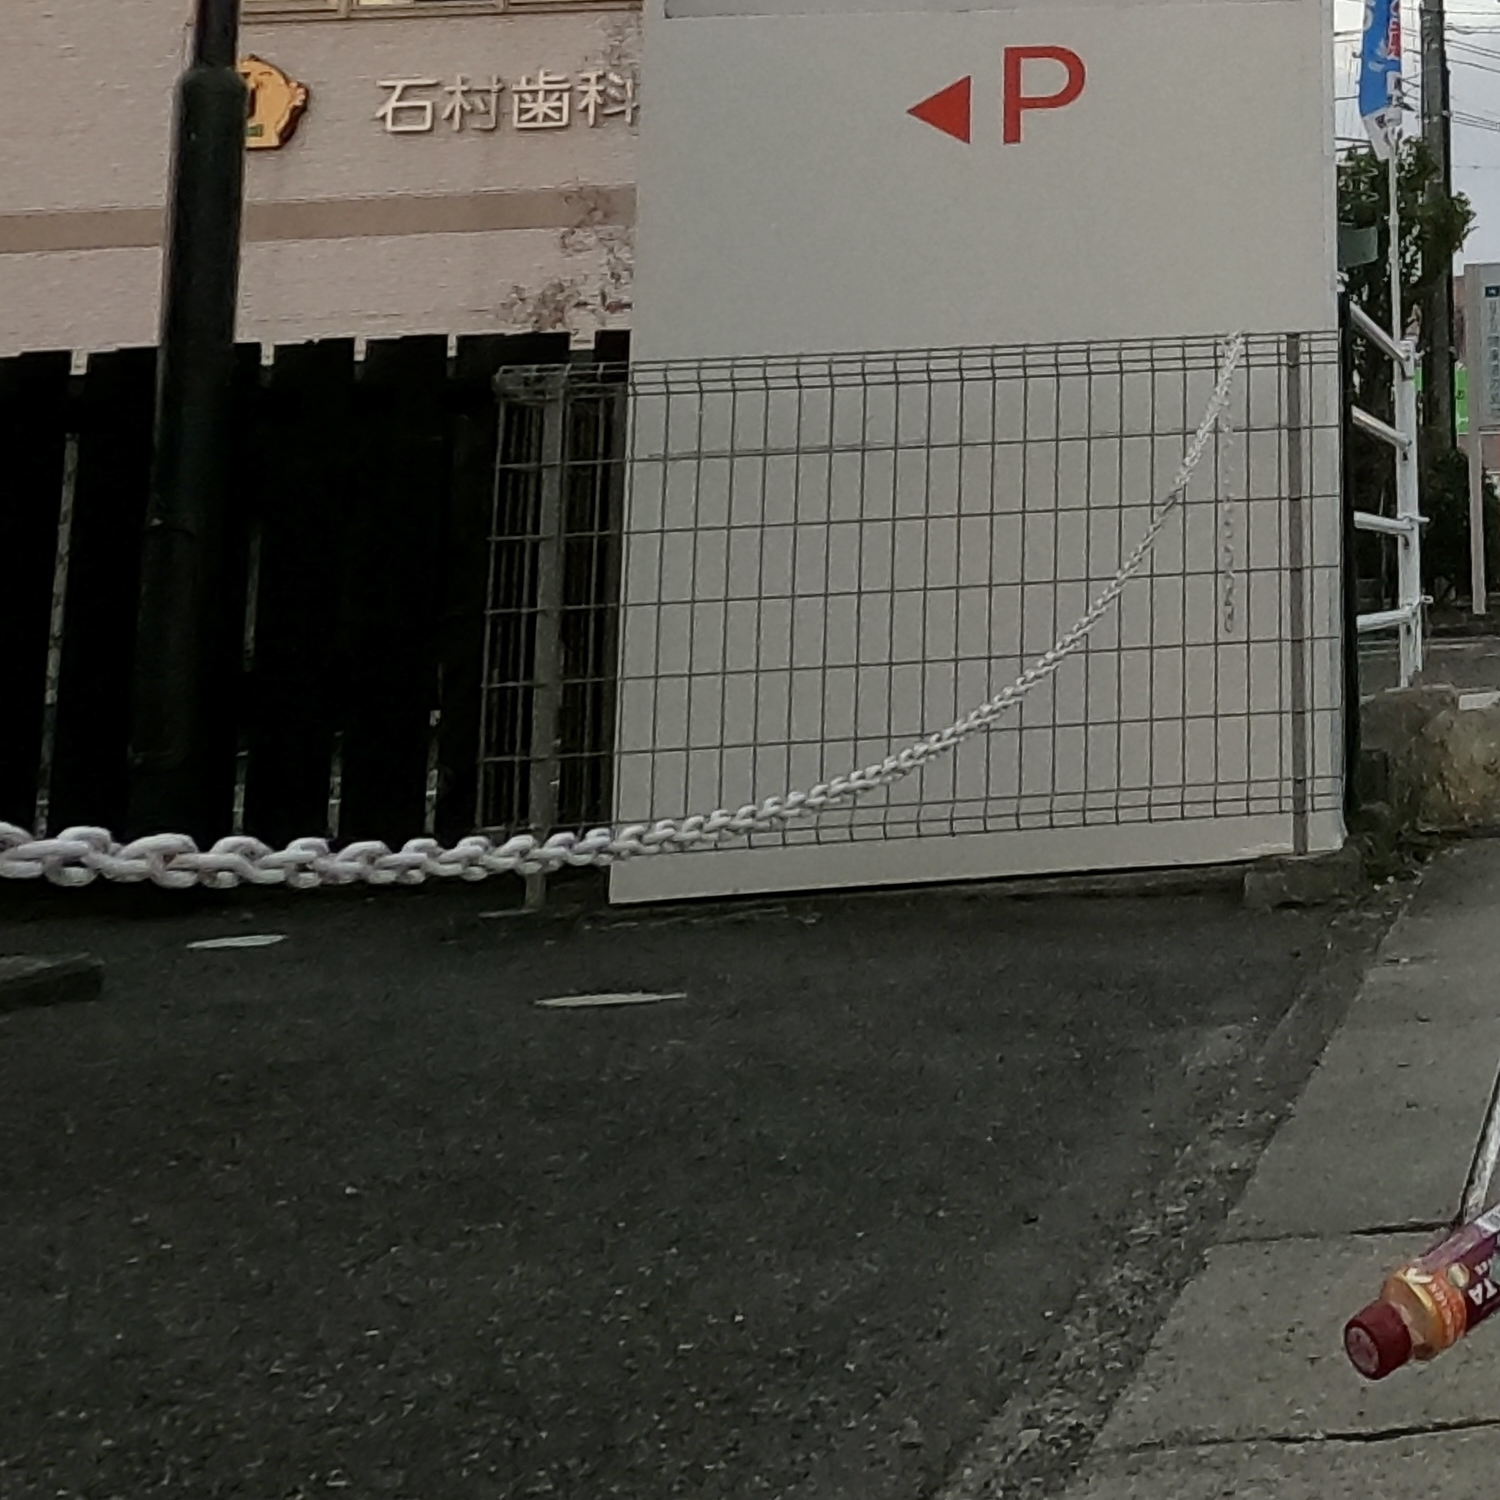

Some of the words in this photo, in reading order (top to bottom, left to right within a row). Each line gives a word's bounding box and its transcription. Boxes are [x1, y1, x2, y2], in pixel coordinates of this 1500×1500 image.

[375, 68, 641, 132] 石村歯科
[1002, 44, 1087, 145] P
